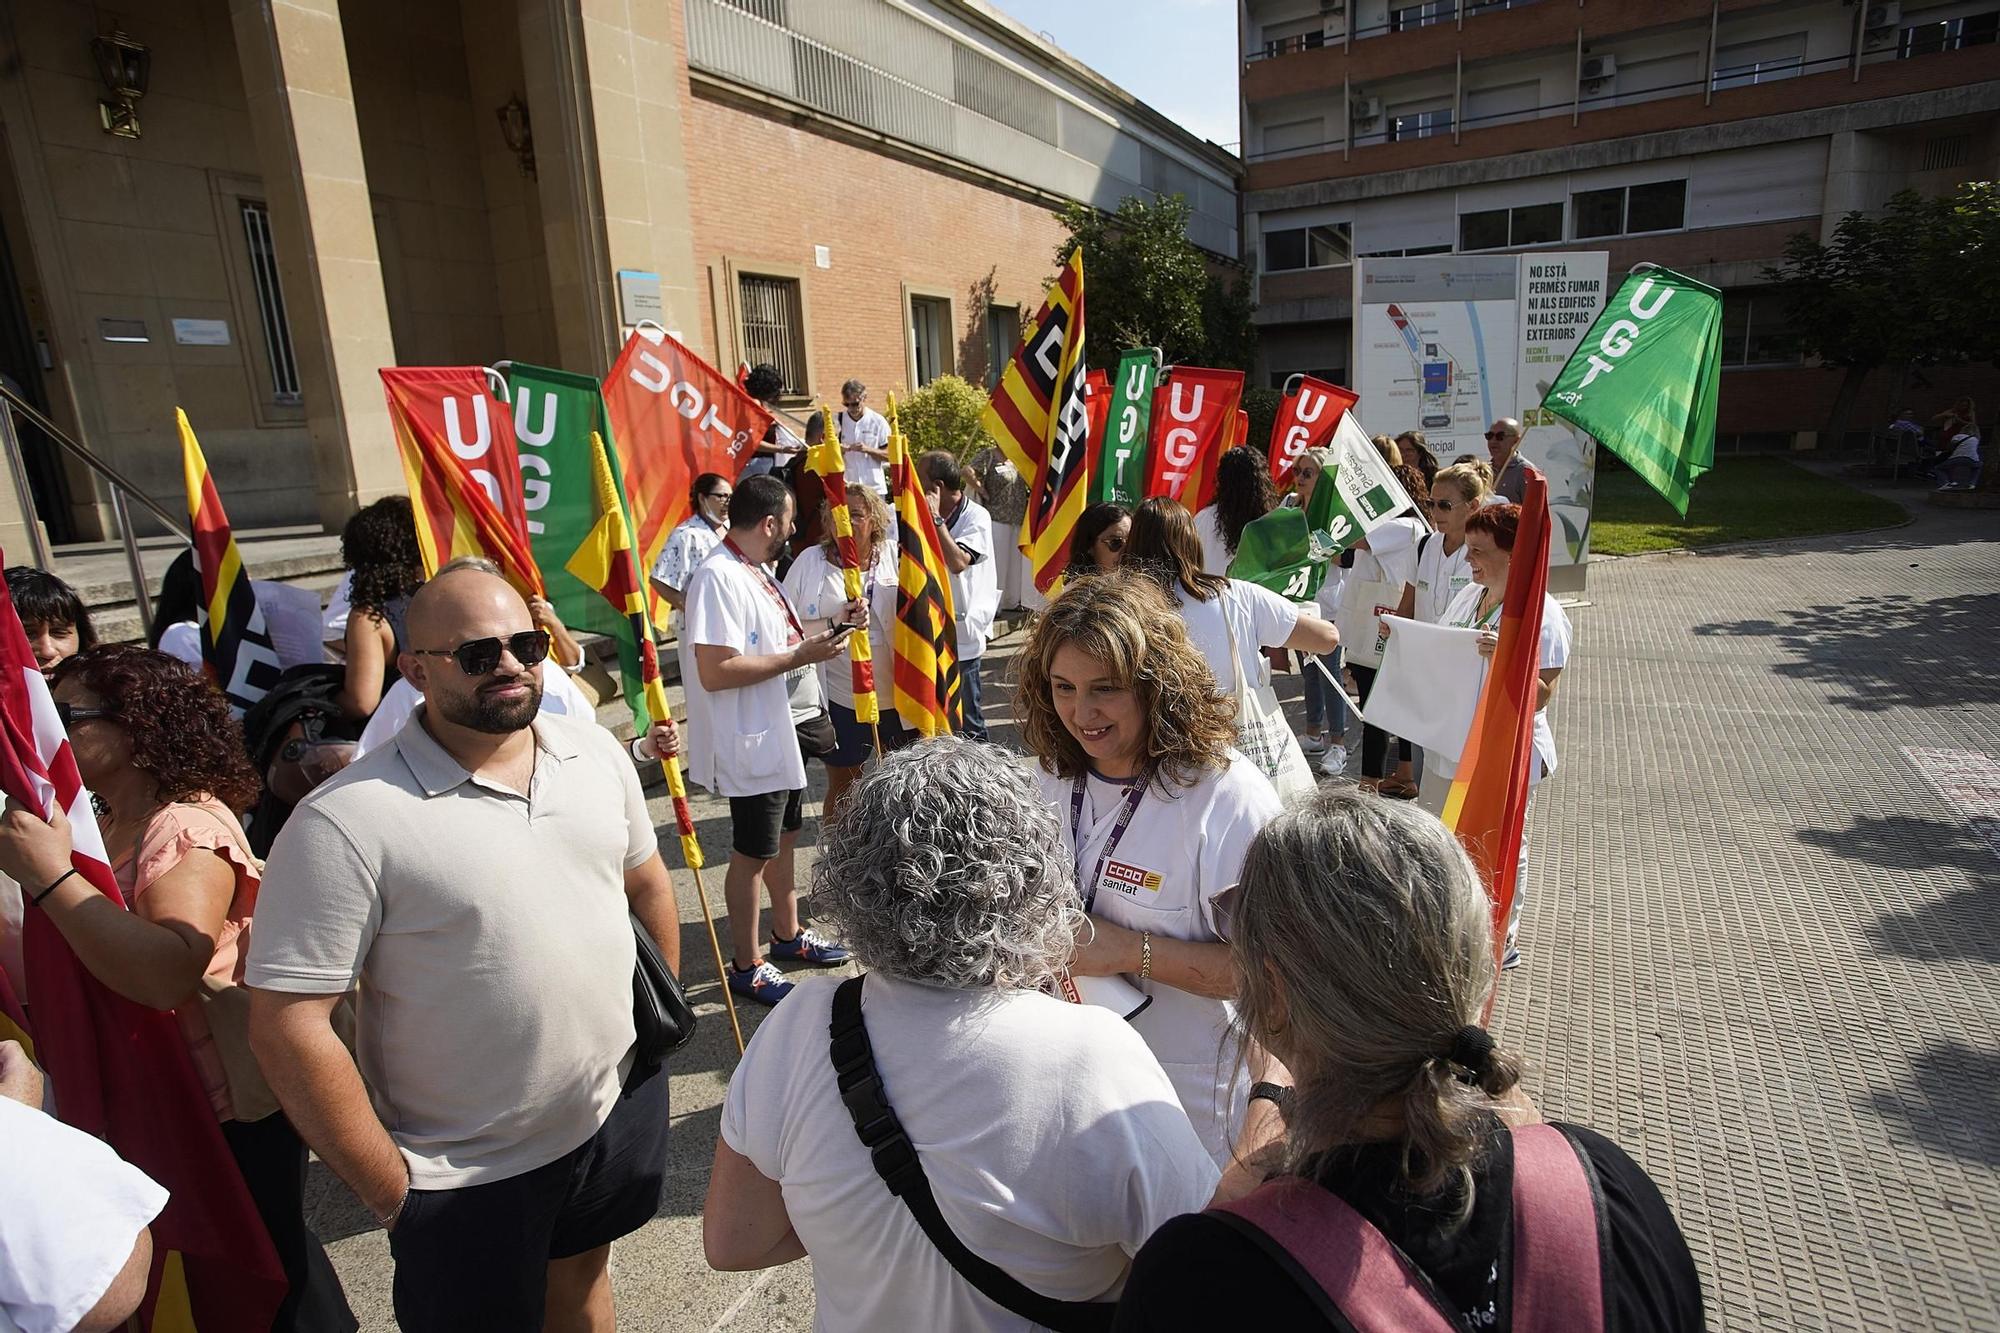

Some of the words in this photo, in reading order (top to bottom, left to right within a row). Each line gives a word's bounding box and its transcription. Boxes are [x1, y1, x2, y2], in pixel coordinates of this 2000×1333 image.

[1529, 265, 1543, 279] NO
[1567, 280, 1600, 293] FUMAR
[1528, 297, 1538, 310] NI
[1539, 297, 1557, 310] ALS
[1558, 295, 1596, 309] EDIFICIS
[1527, 313, 1537, 326] NI
[1538, 312, 1556, 325] ALS
[1557, 311, 1589, 324] ESPAIS
[1526, 328, 1576, 341] EXTERIORS
[1577, 277, 1676, 389] UGT
[1162, 382, 1205, 501] UGT
[1427, 439, 1456, 454] incipal
[1108, 864, 1143, 883] CCOO
[1102, 878, 1138, 896] sanitat
